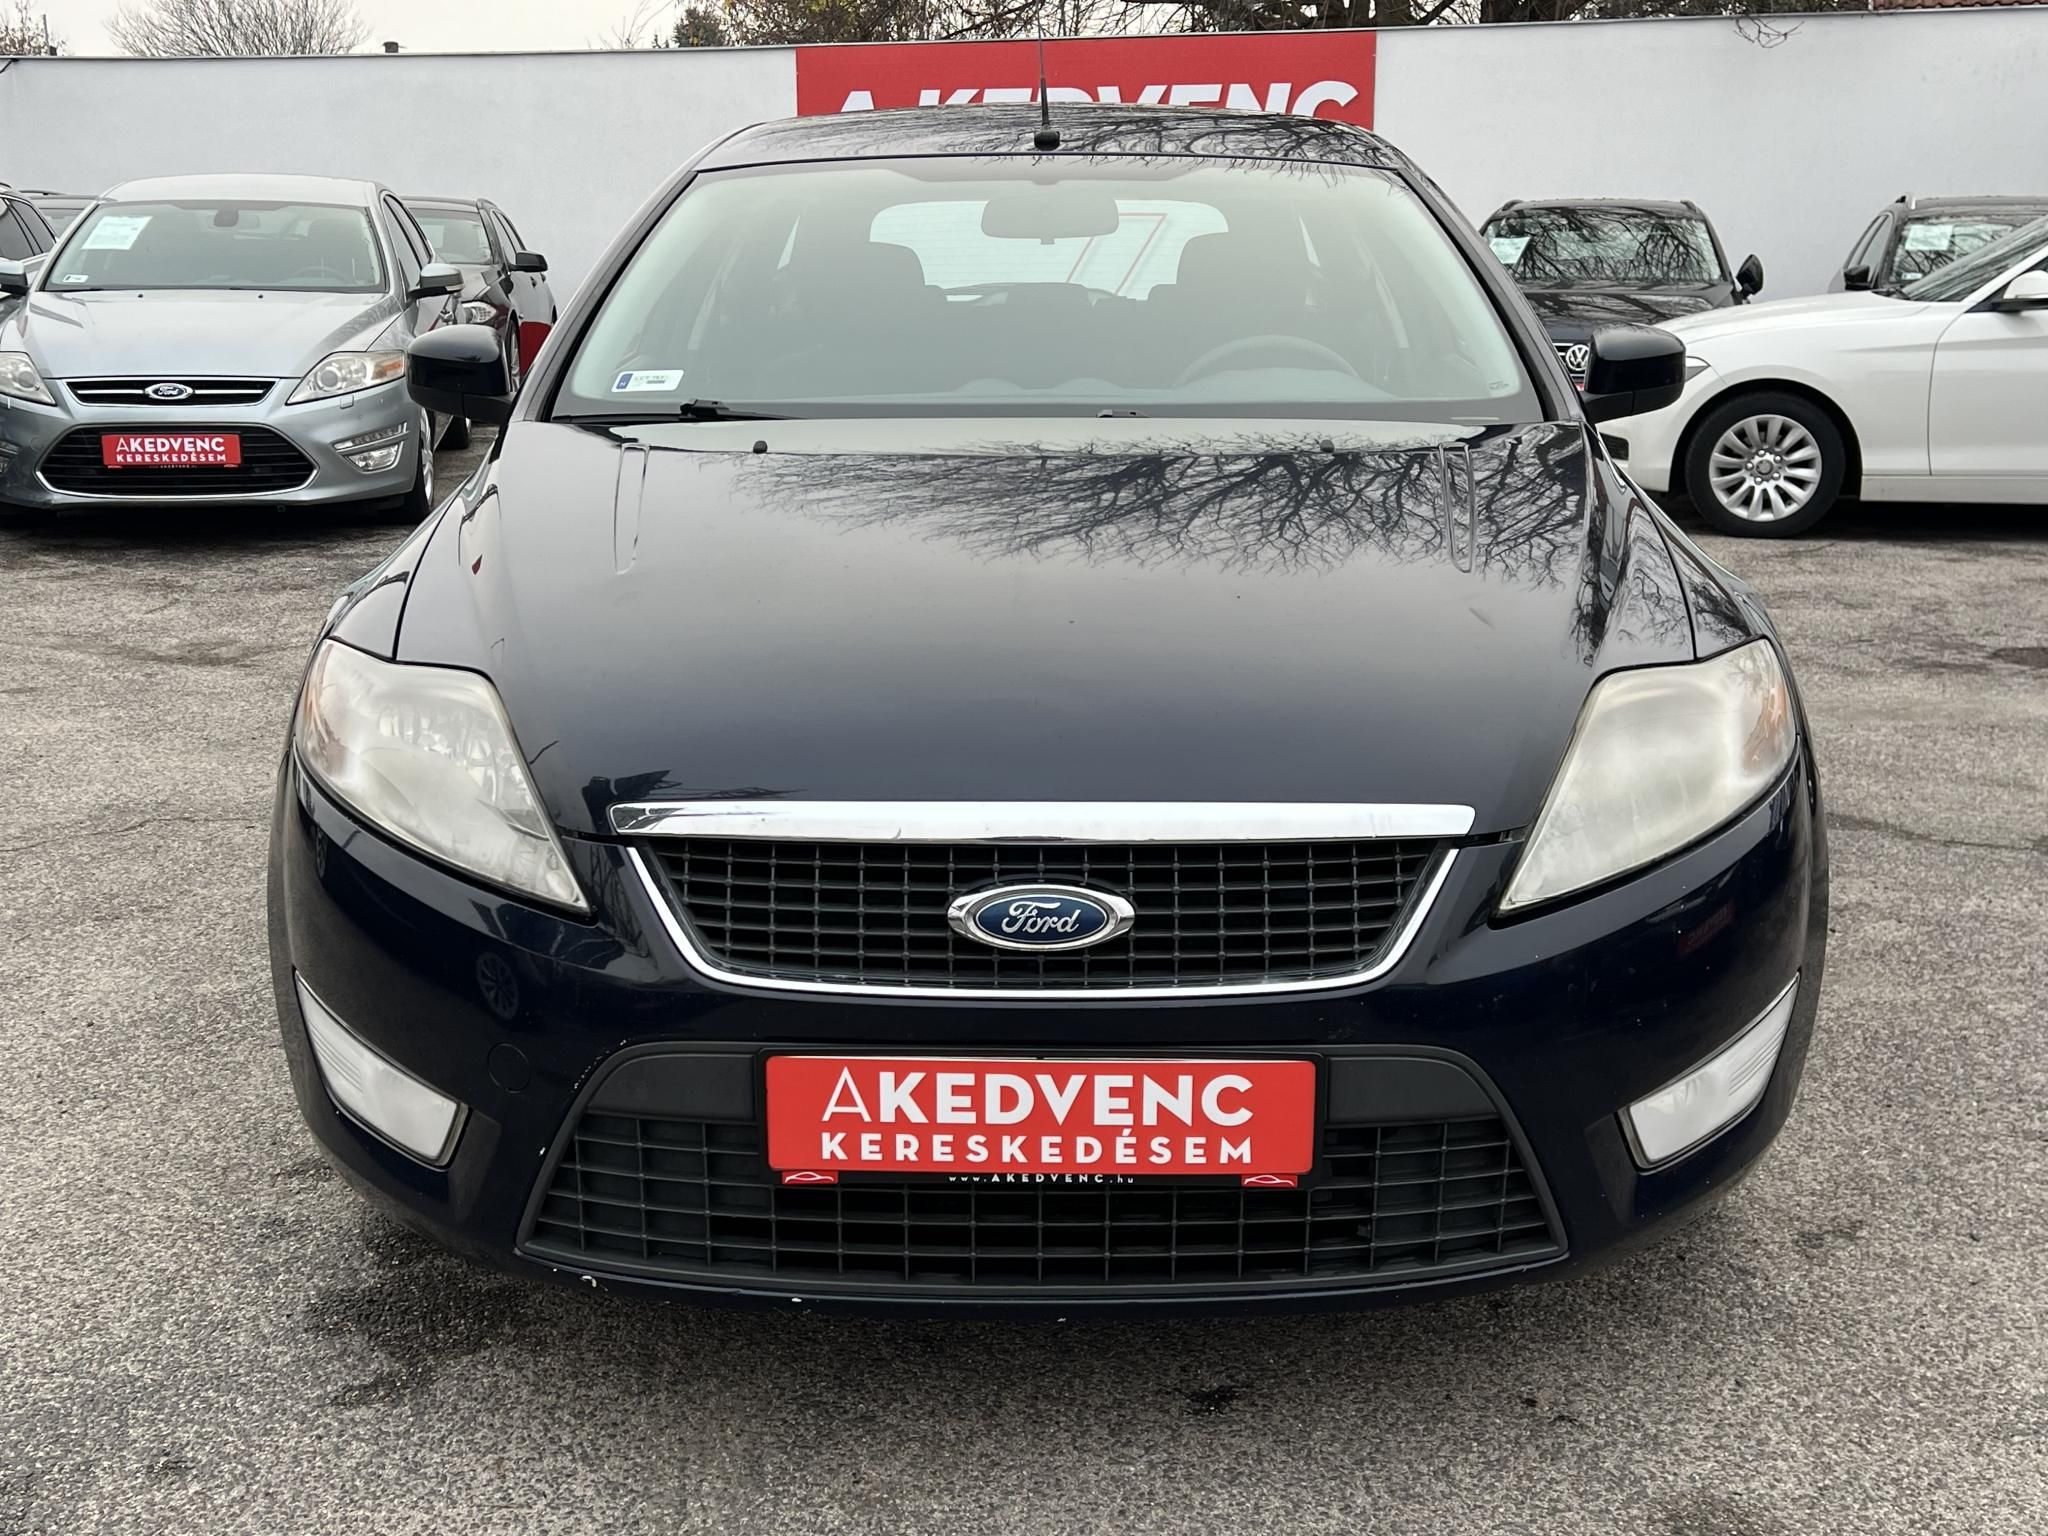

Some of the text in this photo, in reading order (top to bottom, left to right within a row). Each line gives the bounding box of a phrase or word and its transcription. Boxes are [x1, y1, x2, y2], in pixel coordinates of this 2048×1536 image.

[116, 452, 226, 463] KERESKEDÉSEM
[1001, 901, 1081, 933] Ford
[821, 1128, 1252, 1165] KERESKEDÉSEM
[949, 1174, 1134, 1183] www.AKEDVENC.hu
